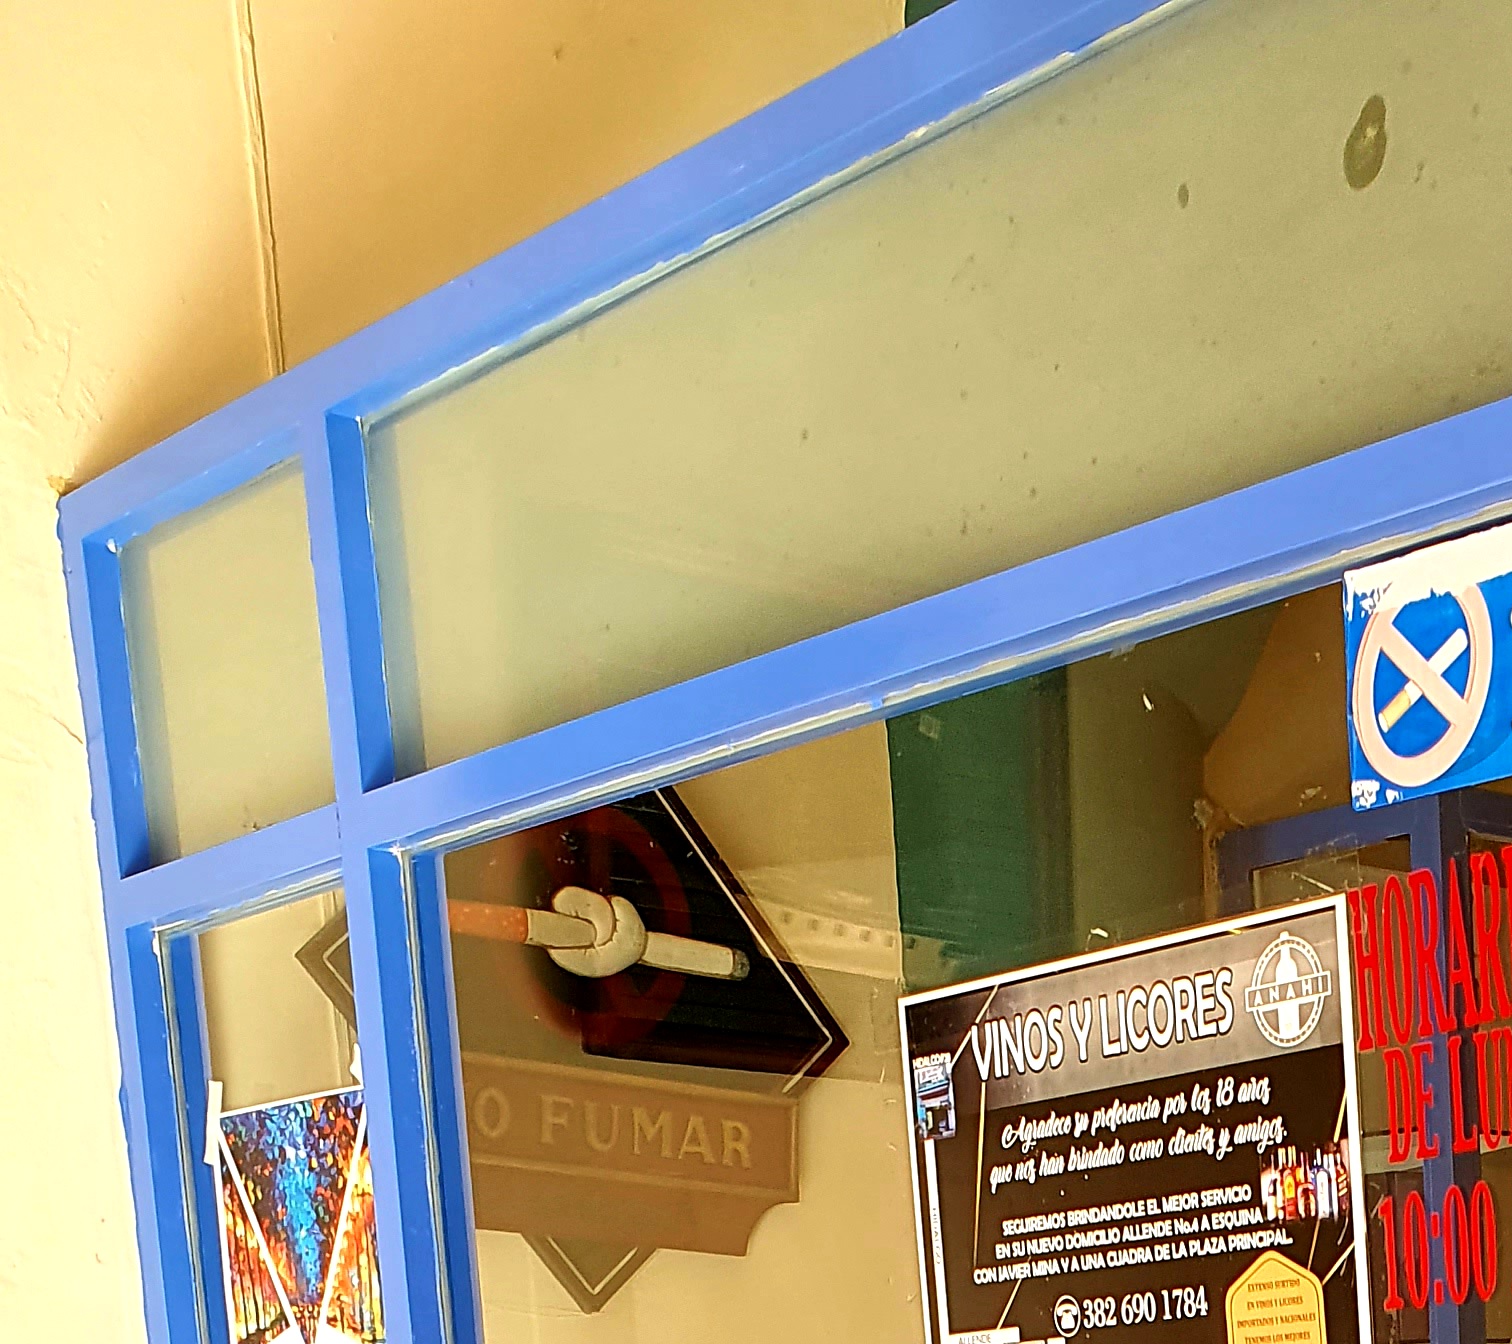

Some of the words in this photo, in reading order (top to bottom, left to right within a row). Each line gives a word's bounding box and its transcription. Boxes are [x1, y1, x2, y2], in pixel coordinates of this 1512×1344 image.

[1253, 974, 1325, 1007] ANAHI
[971, 1006, 1064, 1082] VINOS
[1068, 998, 1092, 1062] Y
[1099, 967, 1234, 1058] LICORES
[1001, 1110, 1071, 1153] Agradece
[1091, 1095, 1161, 1136] preferencia
[1163, 1091, 1187, 1123] por
[1216, 1076, 1235, 1107] 18
[1383, 1041, 1439, 1164] DE
[541, 1094, 752, 1170] FUMAR
[1039, 1151, 1064, 1177] han
[1067, 1139, 1125, 1172] brindado
[1129, 1137, 1163, 1163] como
[1168, 1123, 1215, 1156] clientes
[1216, 1127, 1233, 1161] y
[995, 1243, 1011, 1259] EN
[1012, 1240, 1026, 1258] SU
[1027, 1235, 1064, 1255] NUEVO
[1065, 1227, 1121, 1251] DOMICILIO
[1122, 1220, 1173, 1242] ALLENDE
[1200, 1214, 1211, 1232] A
[1211, 1207, 1263, 1230] ESQUINA
[1002, 1211, 1066, 1237] SEGUIREMOS
[1067, 1200, 1146, 1227] BRINDANDOLE
[1146, 1198, 1161, 1216] EL
[1162, 1192, 1200, 1213] MEJOR
[1201, 1184, 1252, 1208] SERVICIO
[973, 1266, 998, 1285] CON
[998, 1261, 1031, 1282] JAVIER
[1032, 1259, 1061, 1277] MINA
[1061, 1257, 1069, 1273] Y
[1070, 1255, 1080, 1272] A
[1080, 1252, 1106, 1271] UNA
[1106, 1245, 1154, 1267] CUADRA
[1154, 1244, 1171, 1262] DE
[1171, 1241, 1188, 1259] LA
[1188, 1237, 1227, 1257] PLAZA
[1377, 1179, 1498, 1312] 10:00
[1083, 1296, 1117, 1329] 382
[1121, 1291, 1157, 1324] 690
[1162, 1285, 1208, 1320] 1784
